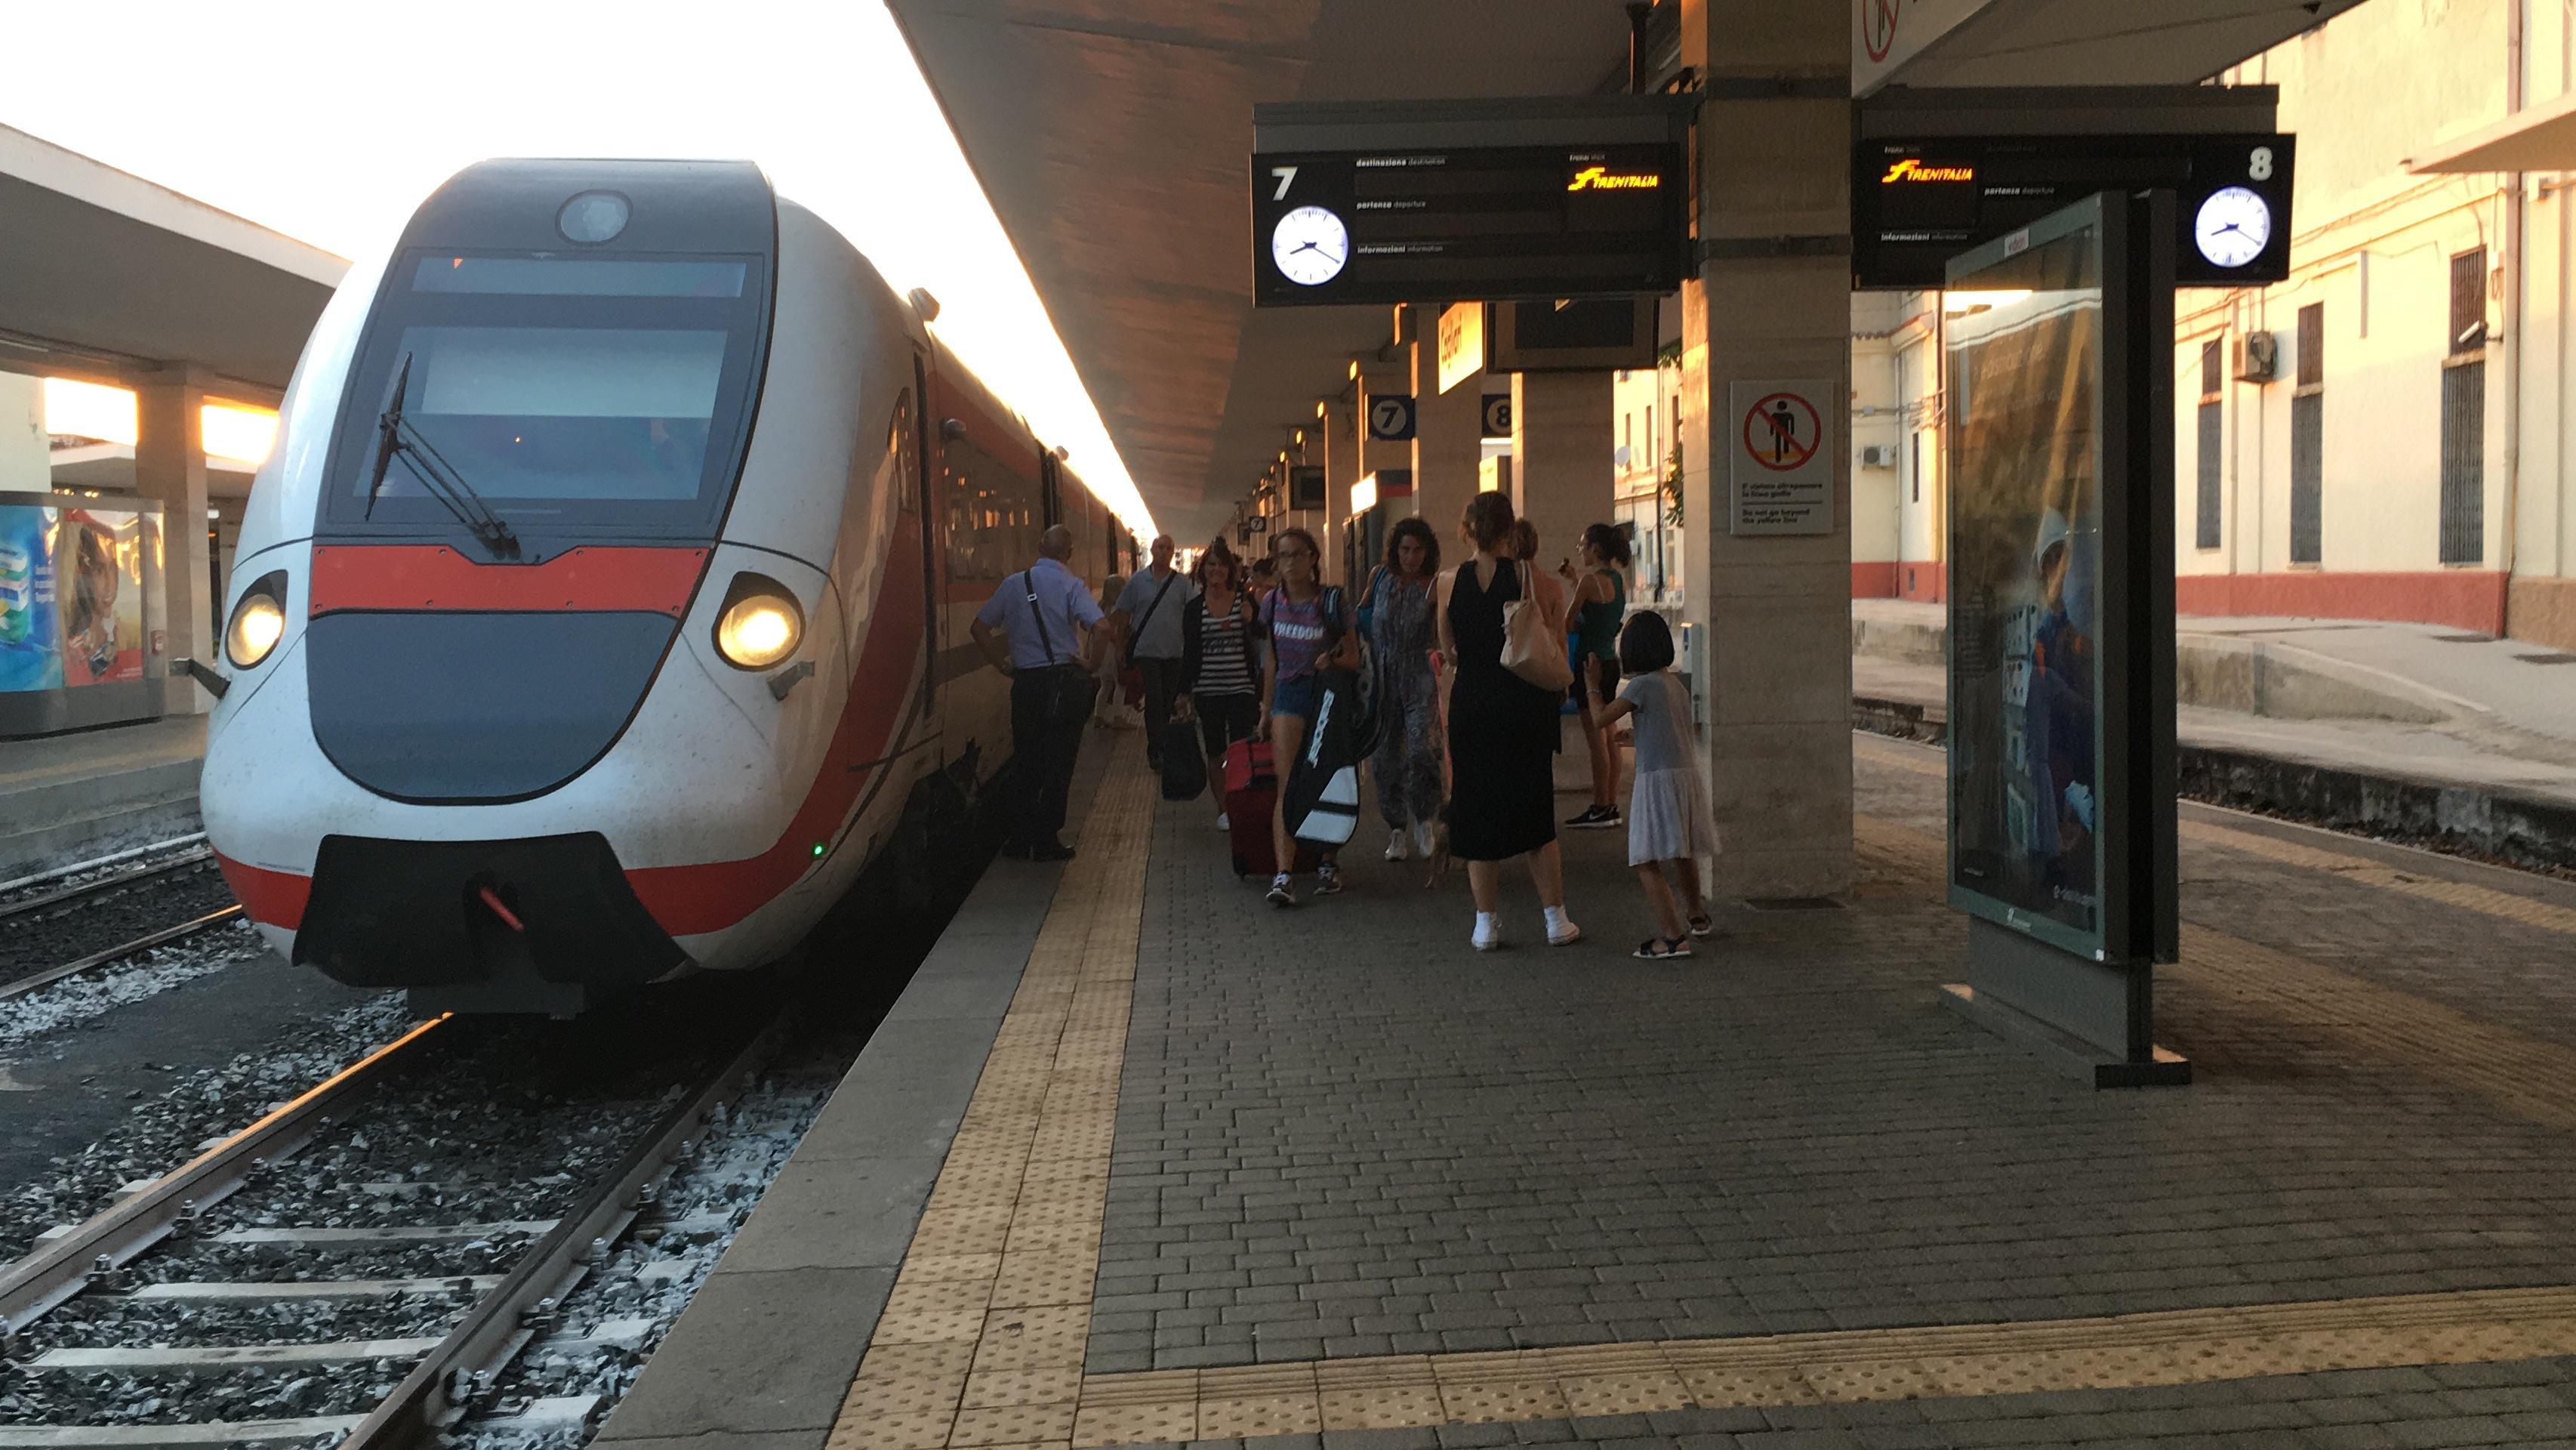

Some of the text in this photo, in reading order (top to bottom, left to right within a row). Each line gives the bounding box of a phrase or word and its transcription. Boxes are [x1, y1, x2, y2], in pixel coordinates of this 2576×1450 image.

[1356, 157, 1407, 168] destinazione
[2248, 146, 2273, 181] 8
[1593, 175, 1658, 189] TRENITALIA
[1907, 168, 1973, 182] TRENITALIA
[1271, 167, 1299, 202] 7
[1984, 187, 2020, 196] partenza
[1357, 201, 1392, 211] partenza
[1881, 232, 1930, 242] informazioni
[1357, 245, 1406, 255] informazioni
[1380, 406, 1399, 428] 7
[1496, 405, 1511, 427] 8
[1254, 520, 1259, 529] 7
[1274, 622, 1324, 640] FREEDOM
